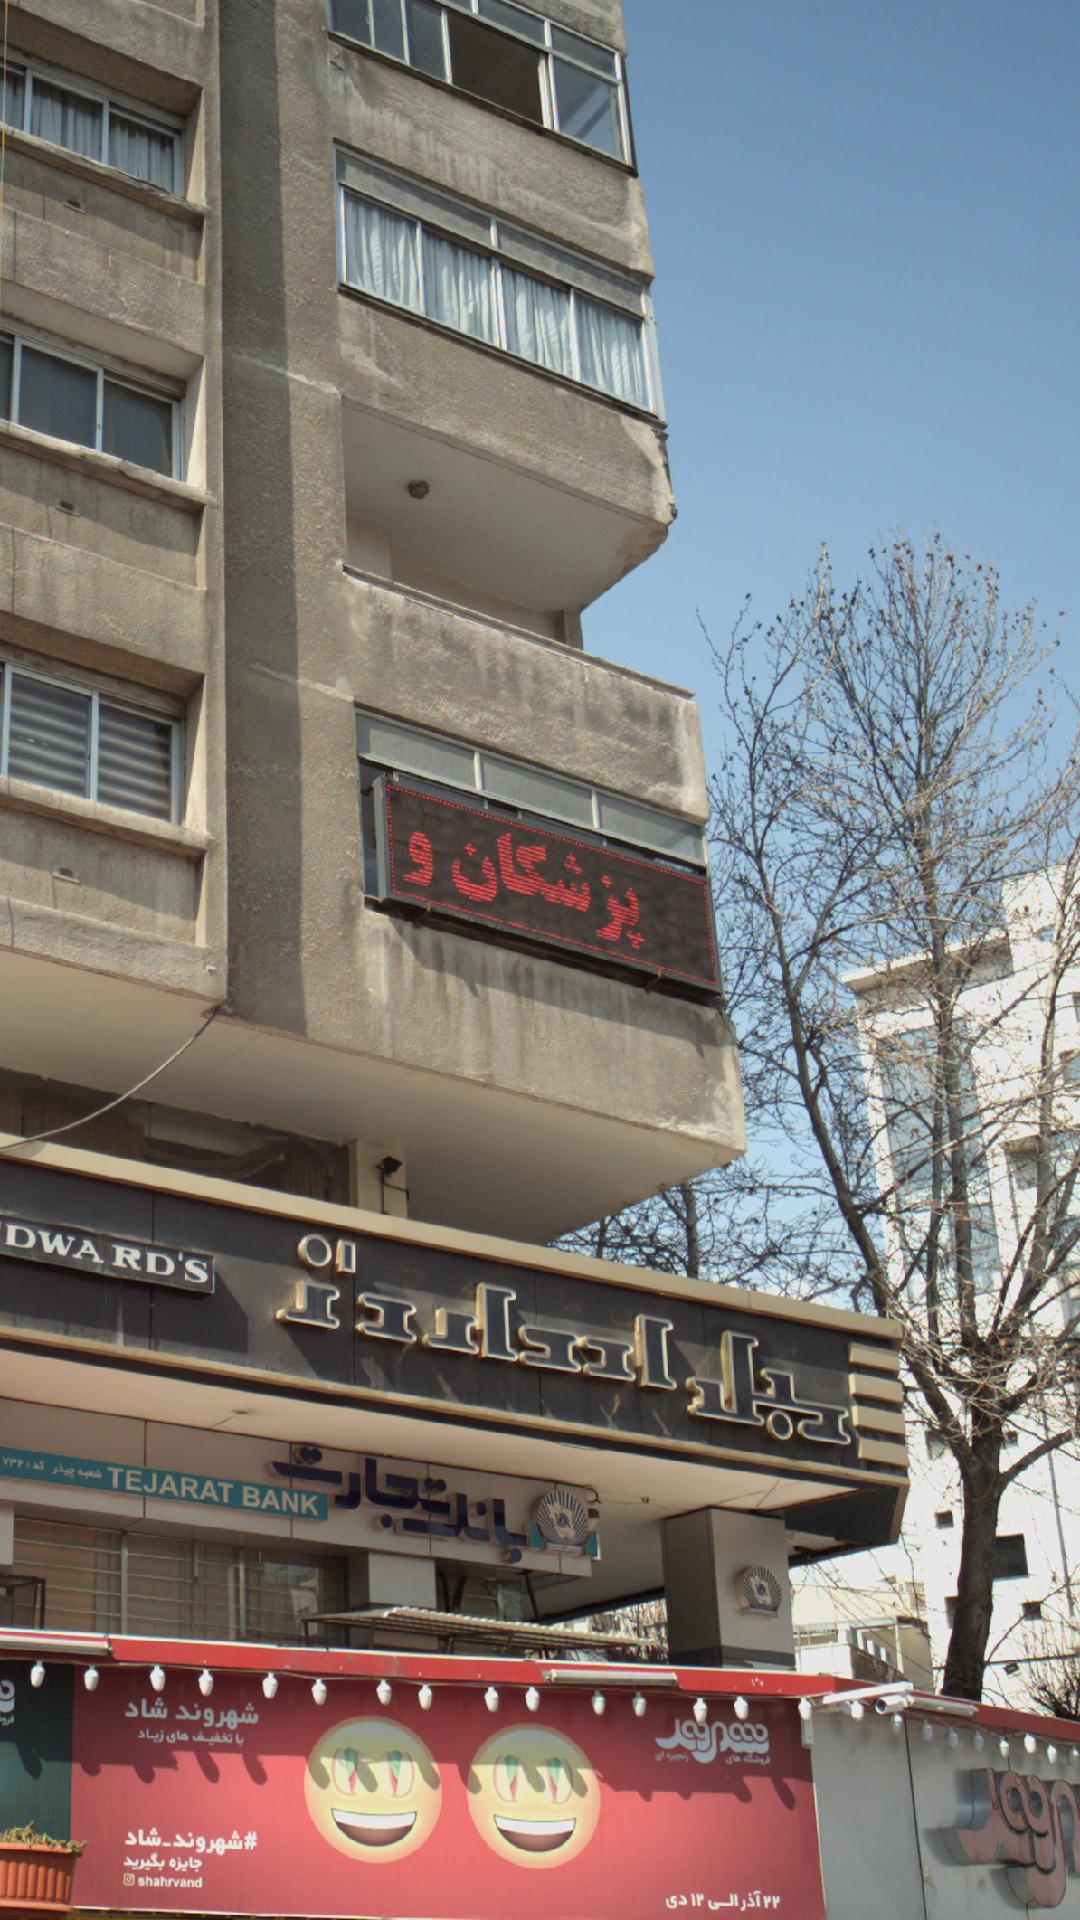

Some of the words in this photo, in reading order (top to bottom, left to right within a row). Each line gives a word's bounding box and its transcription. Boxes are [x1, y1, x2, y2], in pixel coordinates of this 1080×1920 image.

[403, 831, 433, 887] و
[452, 832, 645, 949] پزشکان
[0, 1219, 209, 1283] DWARD'S
[107, 1466, 233, 1504] TEJARAT
[241, 1485, 319, 1516] BANK
[272, 1446, 451, 1529] تجارت
[400, 1494, 528, 1562] بانک
[124, 1698, 168, 1719] شاد
[174, 1702, 259, 1730] شهروند
[137, 1727, 165, 1743] زیاد
[166, 1729, 189, 1744] های
[192, 1731, 233, 1746] تخفیف
[235, 1735, 245, 1747] با
[123, 1852, 166, 1871] بگیرید
[169, 1856, 203, 1873] جایزه
[138, 1875, 203, 1889] shahrvand
[665, 1894, 688, 1909] دی
[690, 1892, 705, 1907] ۱۲
[708, 1893, 739, 1911] الی
[740, 1890, 762, 1912] آذر
